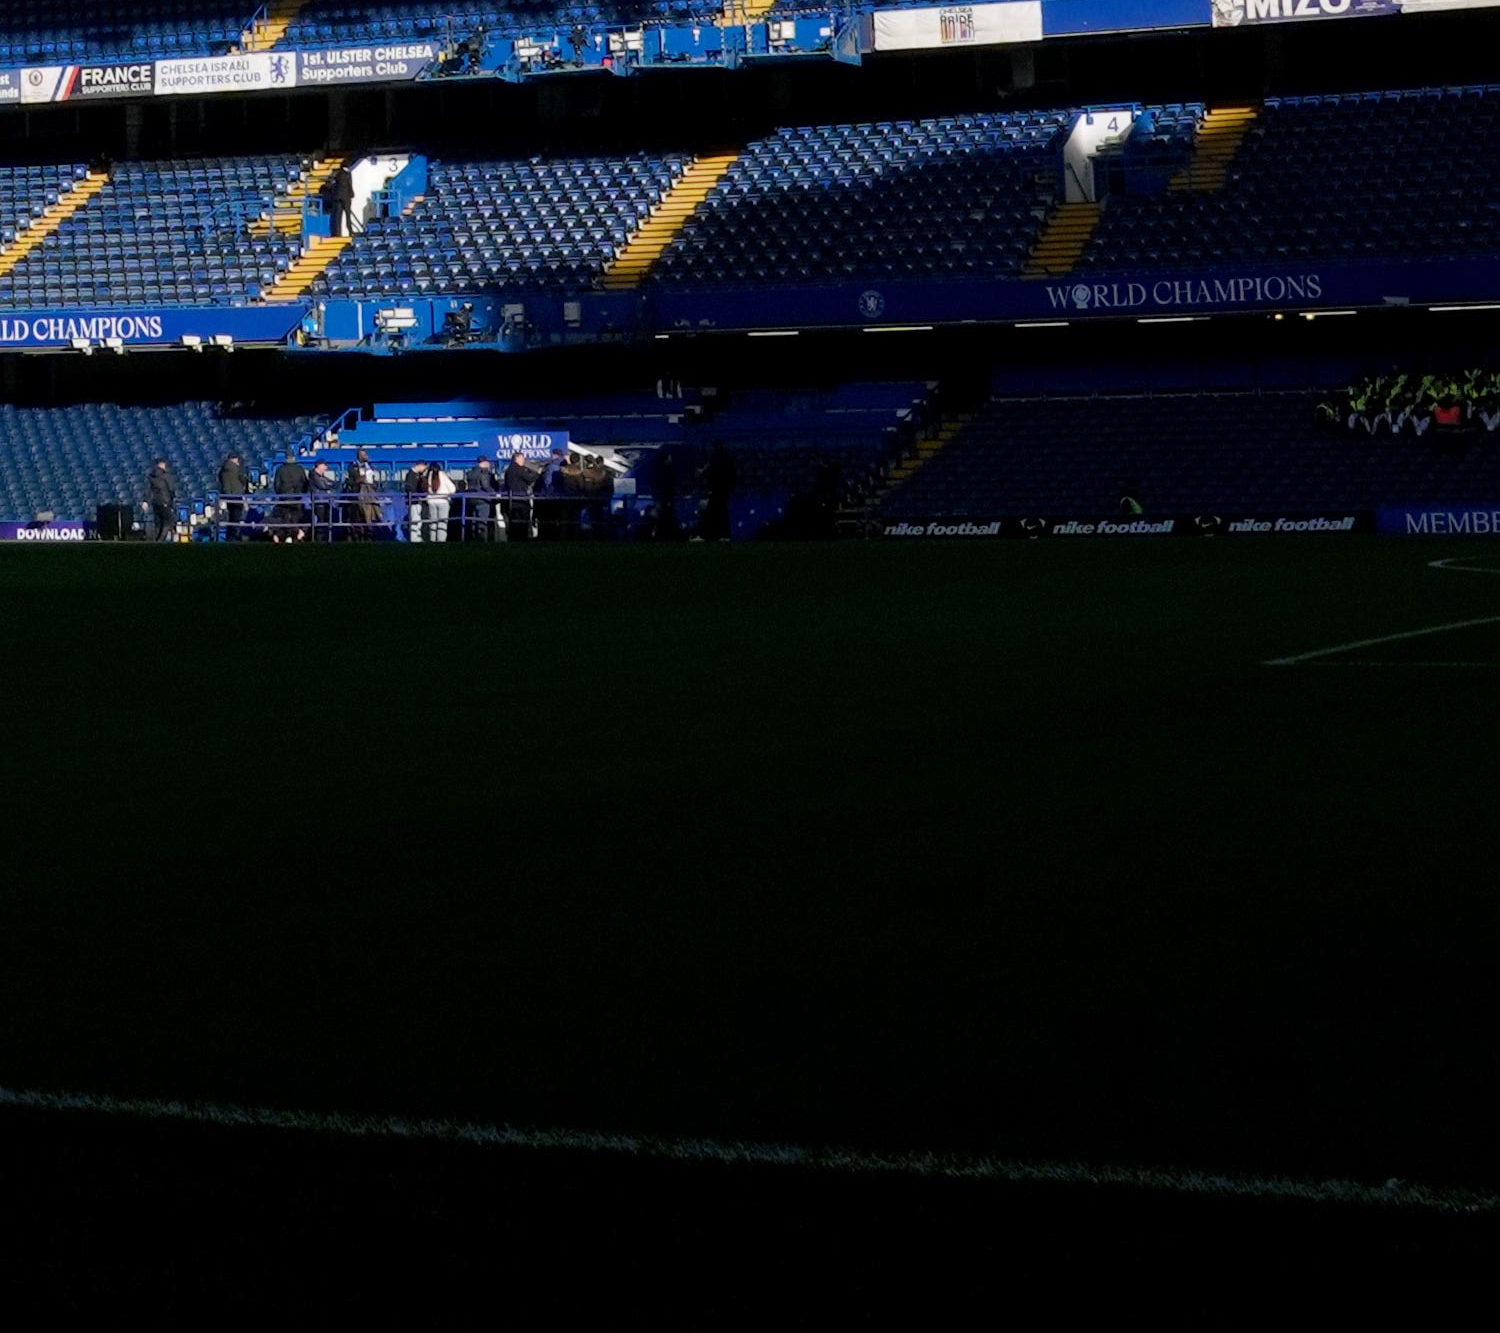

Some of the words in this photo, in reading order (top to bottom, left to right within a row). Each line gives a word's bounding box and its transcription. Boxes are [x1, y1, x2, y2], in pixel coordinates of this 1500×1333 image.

[303, 53, 324, 66] 1st.
[327, 49, 370, 63] ULSTER
[373, 45, 434, 61] CHELSEA
[81, 65, 152, 86] FRANCE
[161, 63, 208, 75] CHELSEA
[302, 65, 373, 81] Supporters
[376, 62, 408, 75] Club
[161, 75, 231, 87] SUPPORTERS
[233, 72, 262, 84] CLUB
[82, 83, 130, 95] SUPPORTERS
[131, 81, 152, 93] CLUB
[1107, 117, 1118, 132] 4
[389, 160, 399, 173] 3
[1045, 283, 1147, 309] WORLD
[1151, 274, 1323, 305] CHAMPIONS
[33, 317, 163, 340] CHAMPIONS
[497, 434, 551, 450] WORLD
[884, 523, 923, 536] nike
[926, 522, 1001, 536] football
[1052, 521, 1094, 536] nike
[1096, 520, 1175, 536] football
[1228, 518, 1272, 534] nike
[1274, 516, 1356, 534] football
[17, 528, 85, 541] DOWNLOAD
